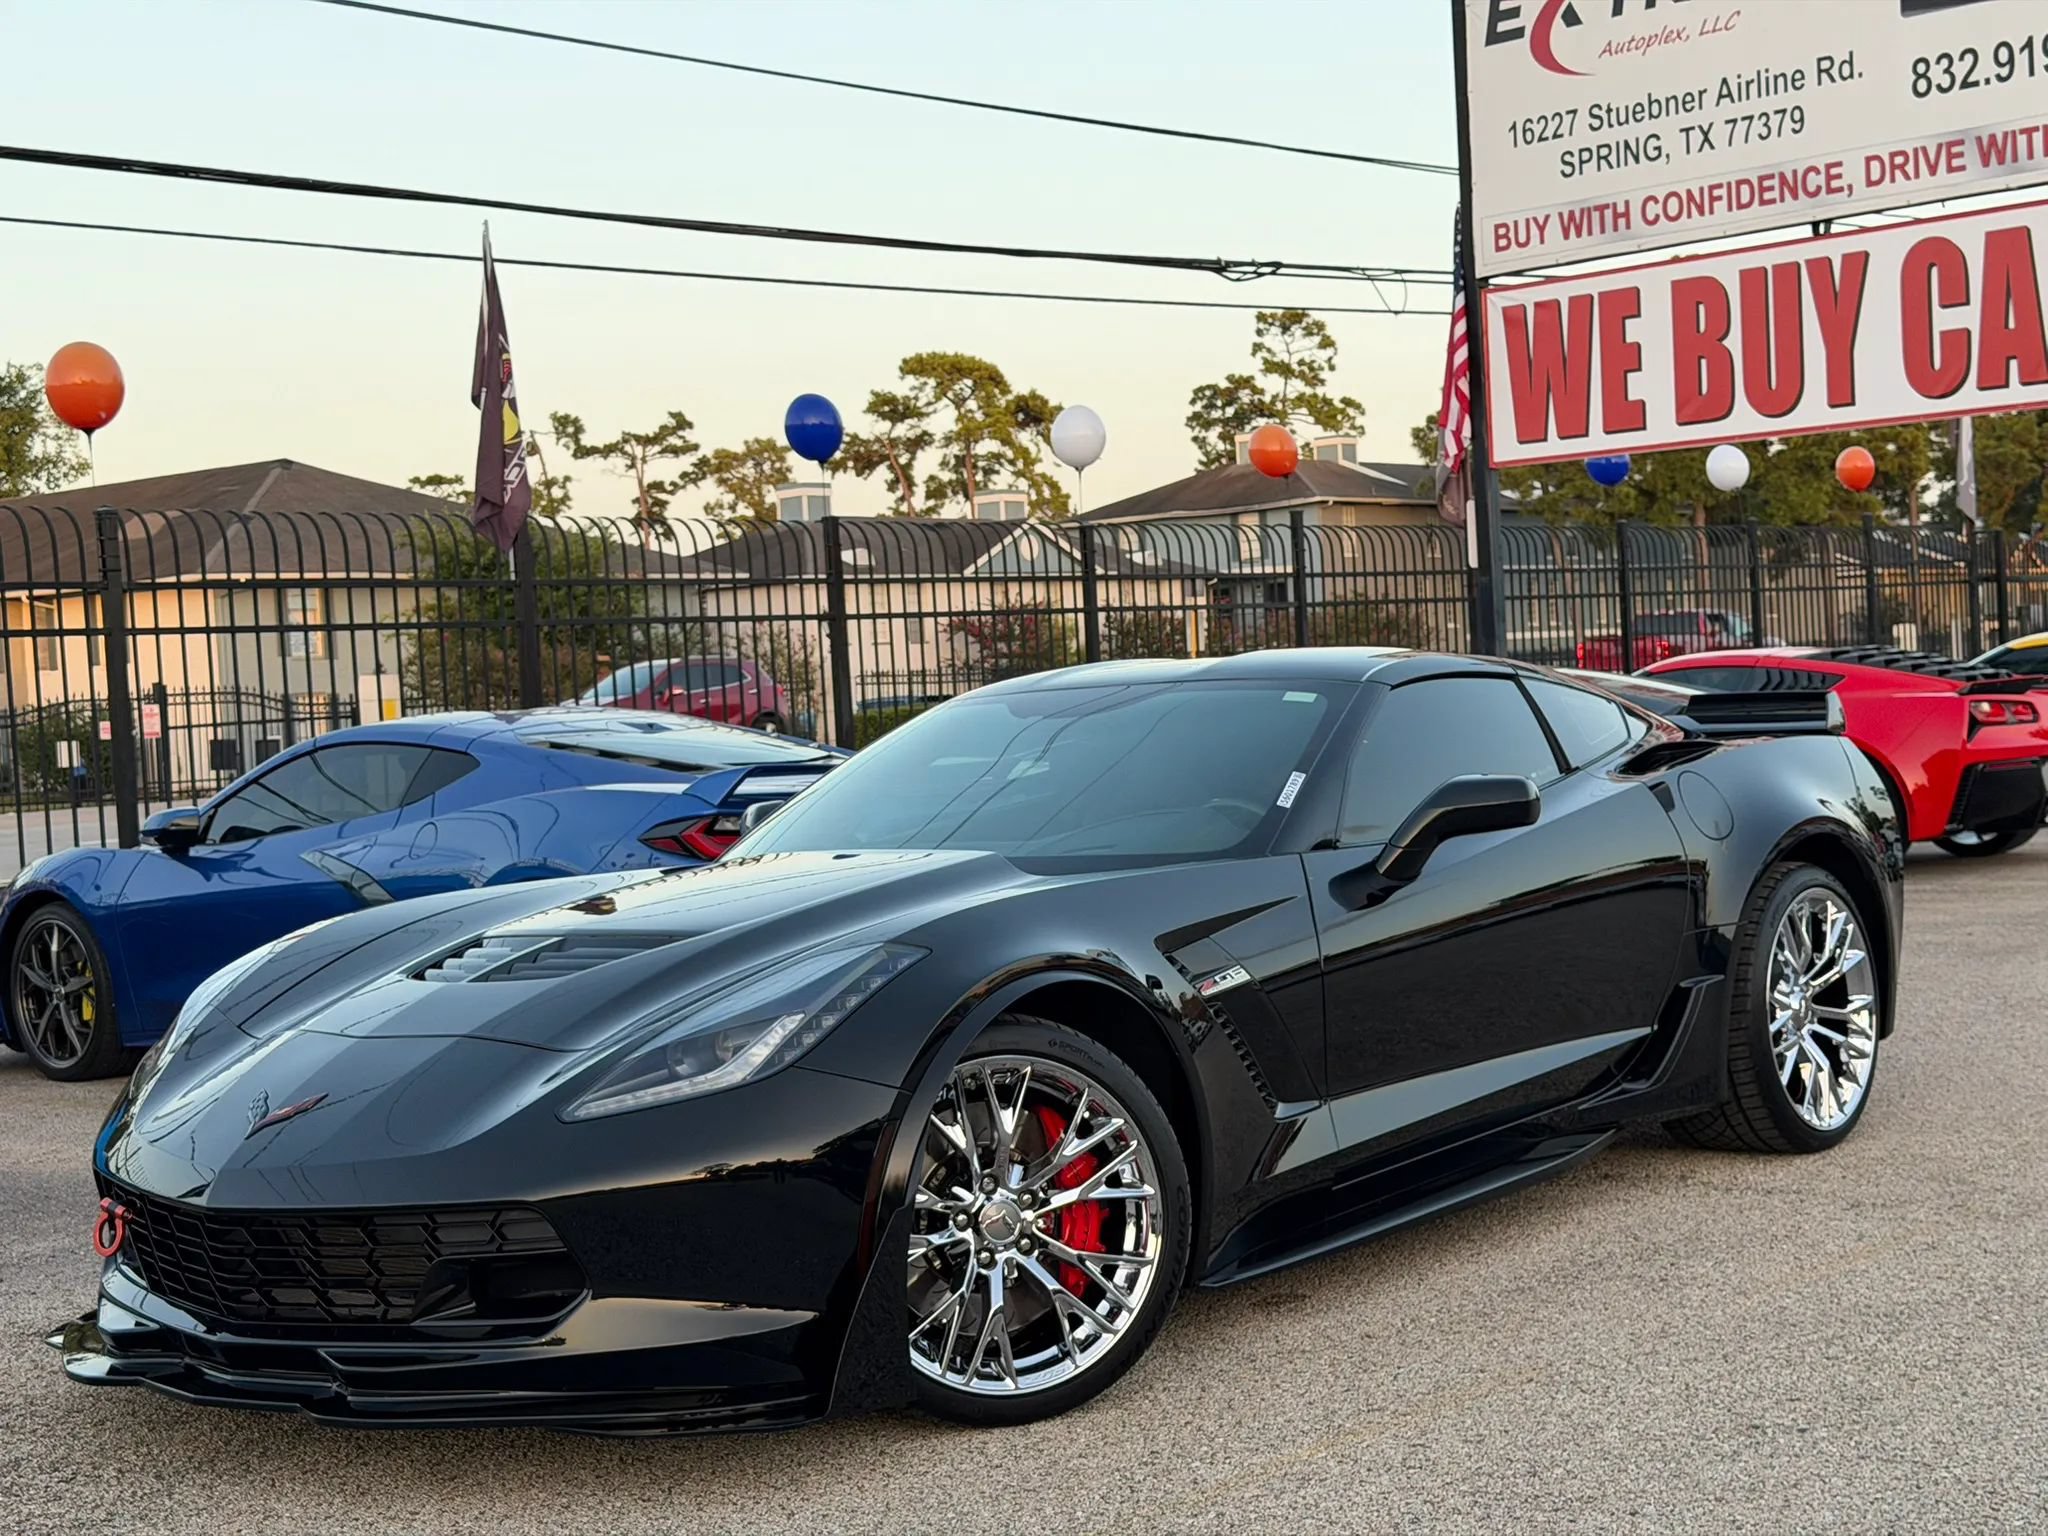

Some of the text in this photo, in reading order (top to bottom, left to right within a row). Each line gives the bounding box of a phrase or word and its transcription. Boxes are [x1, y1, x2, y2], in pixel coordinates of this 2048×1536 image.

[1598, 24, 1690, 58] Autoplex,
[1698, 10, 1741, 37] LLC
[1508, 50, 1864, 148] 16227 Stuebner Airline Rd.
[1560, 105, 1805, 179] SPRING, TX 77379
[1493, 124, 2048, 253] BUY WITH CONFIDENCE, DRIVE WIT
[1502, 225, 2048, 444] WE BUY CA
